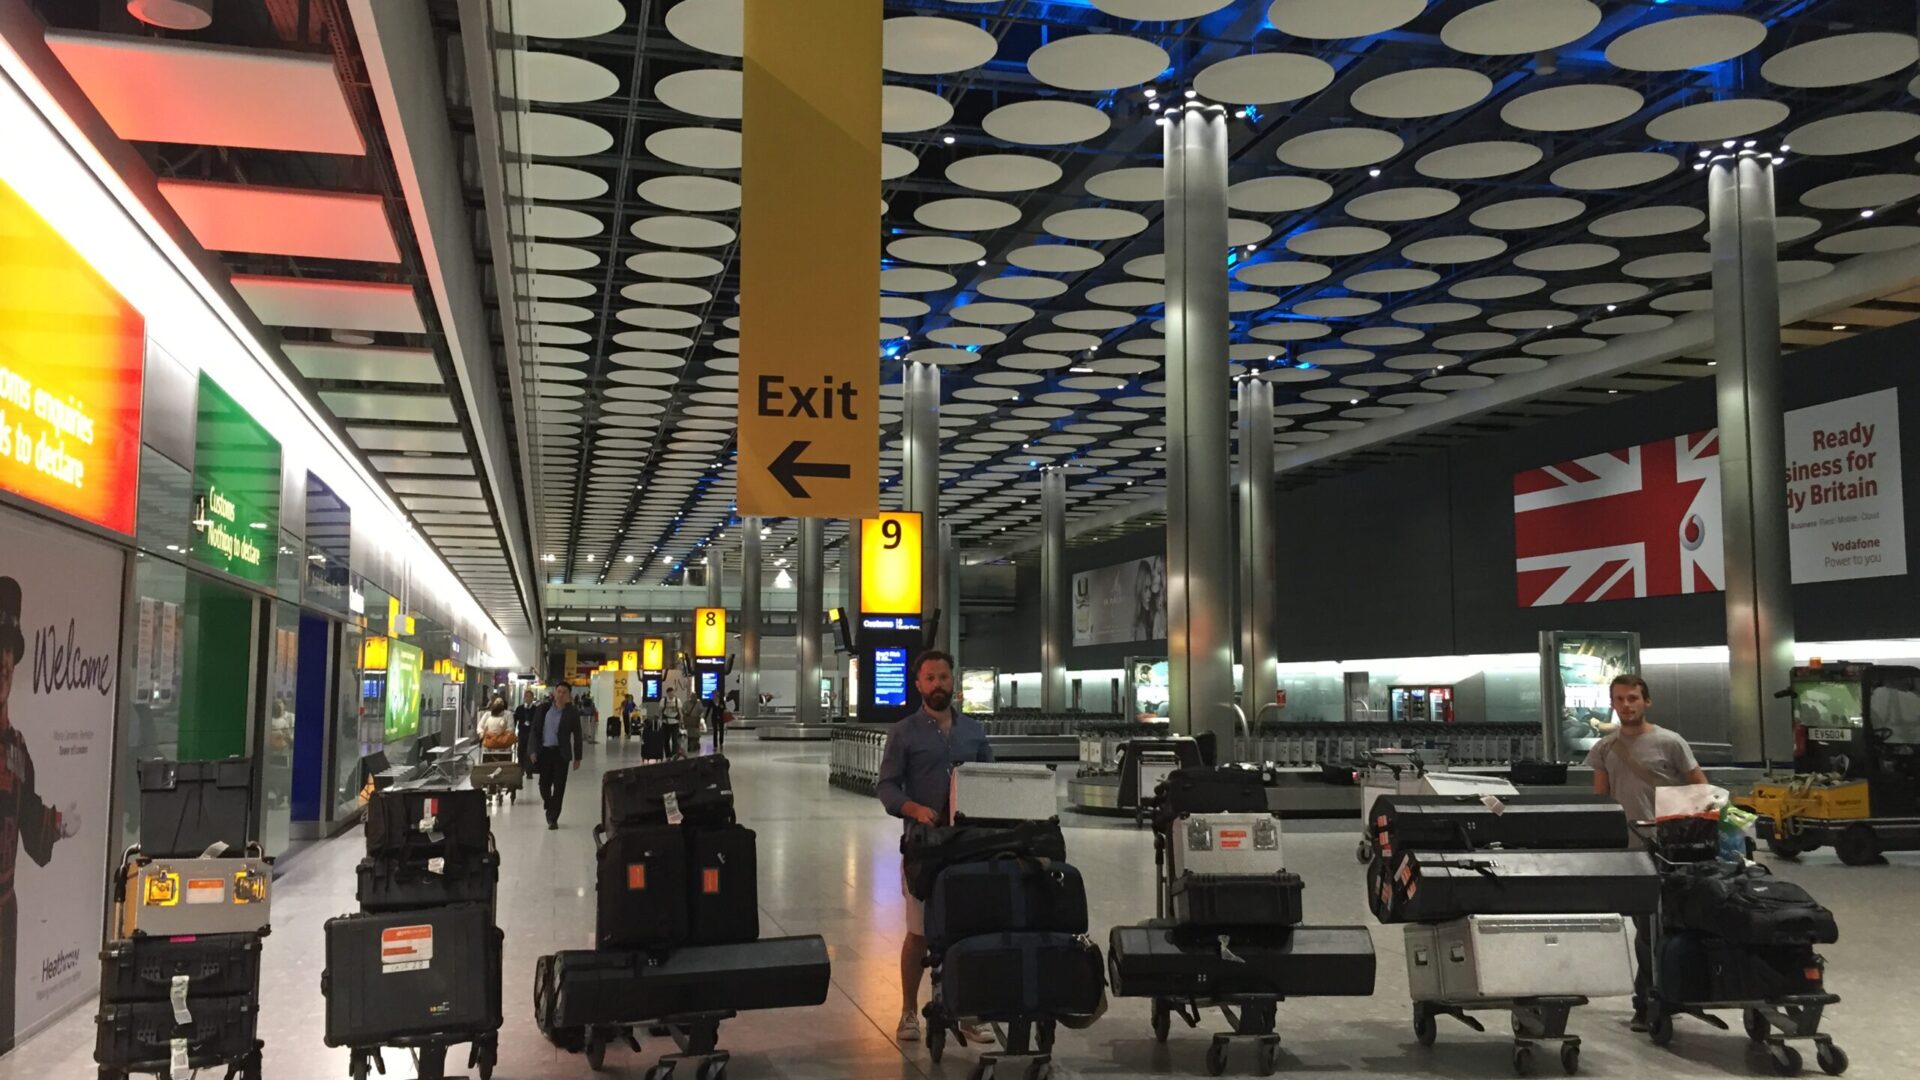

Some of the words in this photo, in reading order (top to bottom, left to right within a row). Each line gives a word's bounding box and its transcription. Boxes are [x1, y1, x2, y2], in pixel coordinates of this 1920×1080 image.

[758, 374, 858, 420] Exit
[34, 387, 95, 446] enquiries
[1813, 422, 1875, 450] Ready
[15, 421, 32, 465] to
[35, 430, 84, 489] declare
[1846, 451, 1877, 472] for
[210, 485, 235, 522] Customs
[1810, 476, 1878, 505] Britain
[208, 521, 233, 561] Nothing
[241, 534, 260, 565] declare
[881, 519, 902, 549] 9
[1832, 538, 1881, 551] Vodafone
[1824, 556, 1852, 568] Power
[1852, 555, 1863, 566] to
[1864, 554, 1882, 567] you
[705, 611, 716, 626] 8
[33, 617, 115, 697] Welcome
[627, 652, 633, 661] 6
[650, 641, 657, 650] 7
